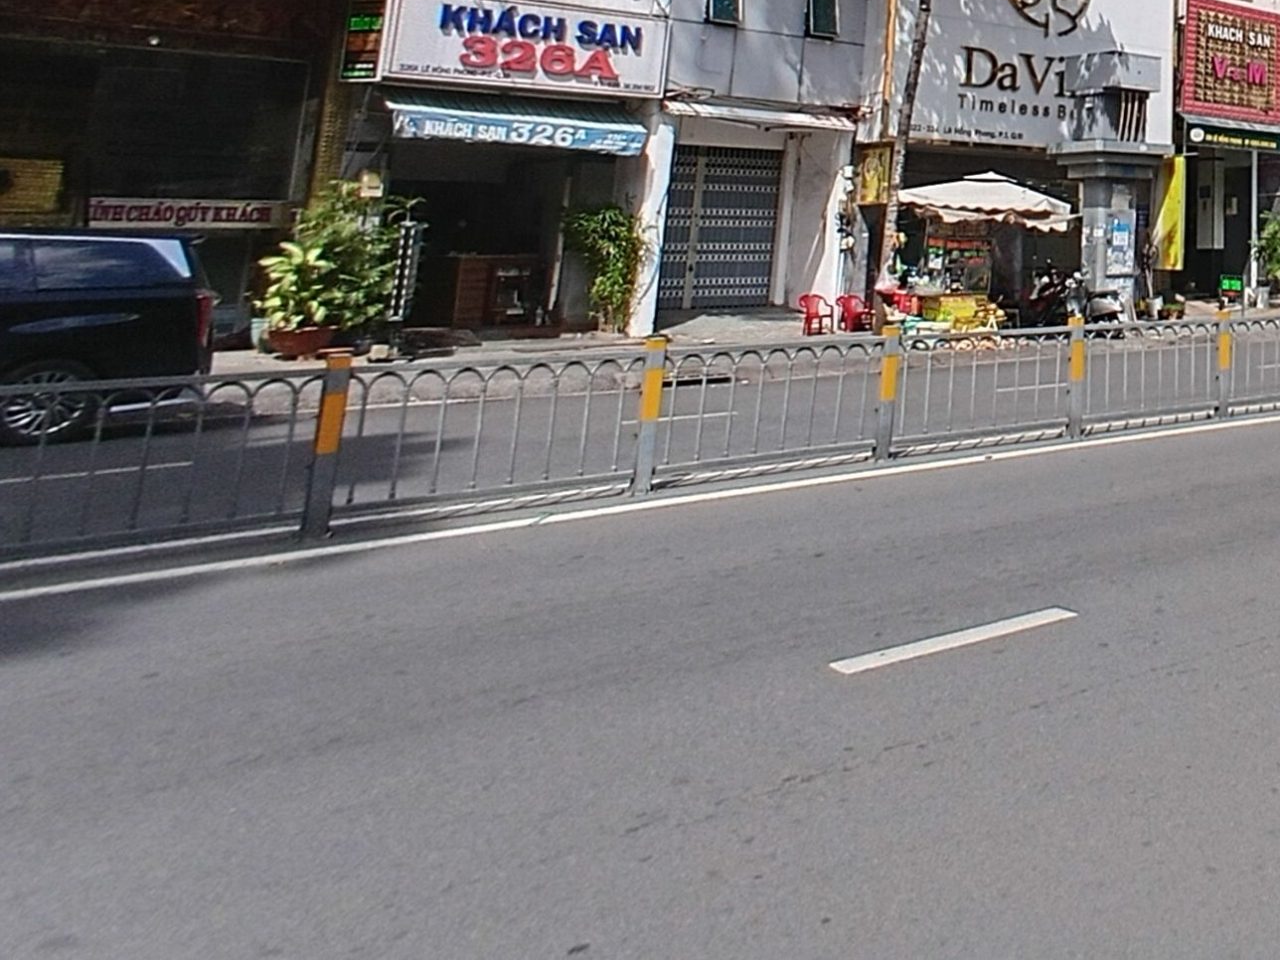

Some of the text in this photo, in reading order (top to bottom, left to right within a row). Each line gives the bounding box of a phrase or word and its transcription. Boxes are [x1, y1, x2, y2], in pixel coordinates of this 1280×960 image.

[439, 4, 566, 42] KHÁCH
[458, 35, 619, 81] 326A
[958, 46, 1078, 98] DaVi
[957, 94, 1050, 117] Timeless
